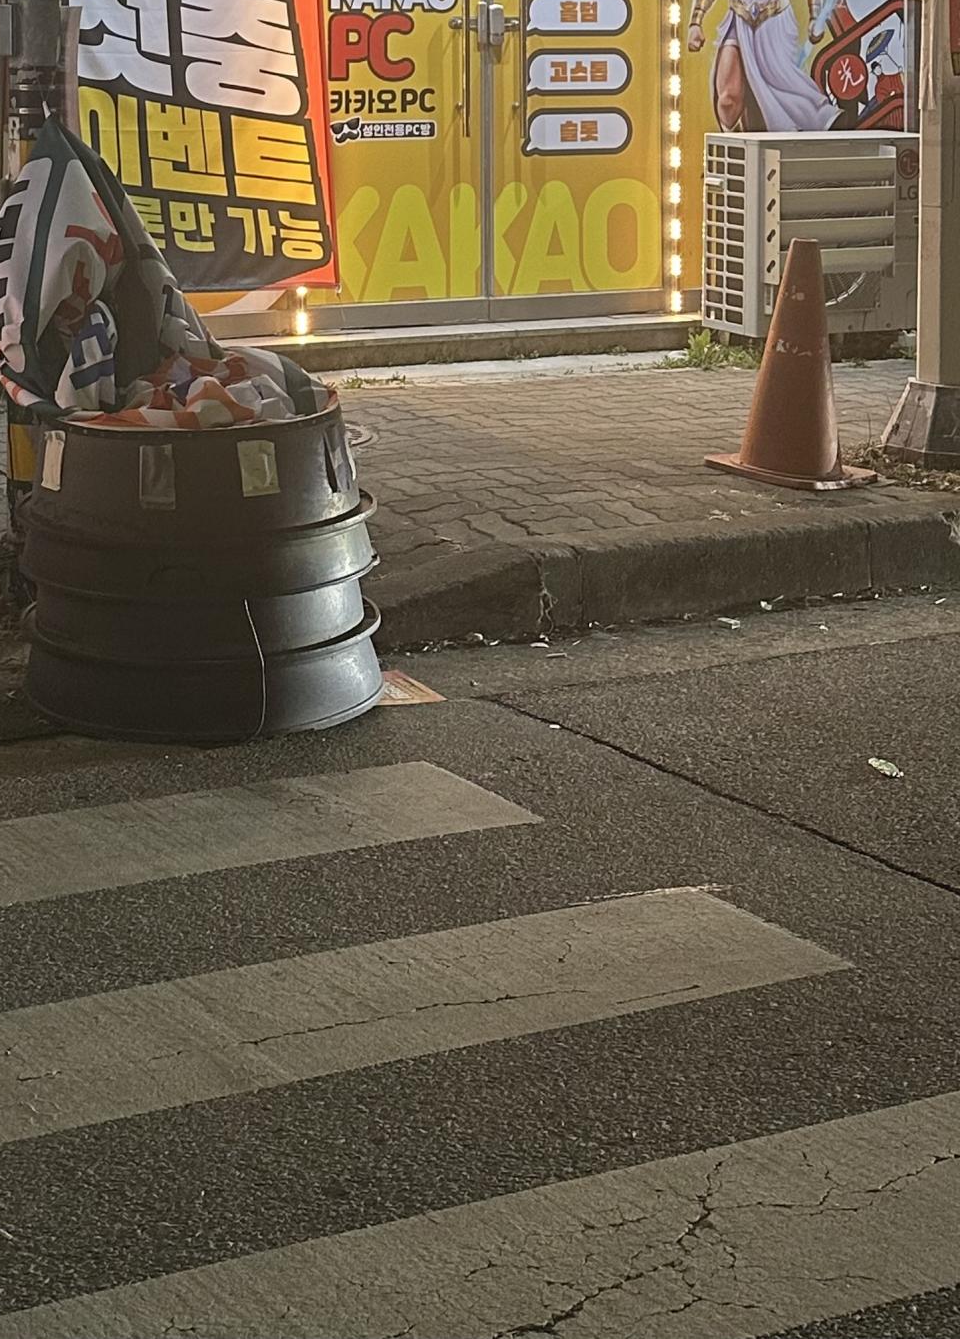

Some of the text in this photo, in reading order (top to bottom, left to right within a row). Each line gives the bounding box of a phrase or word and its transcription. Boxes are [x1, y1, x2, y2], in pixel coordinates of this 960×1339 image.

[328, 11, 415, 82] PC
[78, 85, 316, 205] 이벤트
[362, 124, 431, 136] 성인전용PC방
[898, 186, 919, 202] LG
[227, 206, 325, 262] 가능
[338, 178, 662, 303] KAKAO
